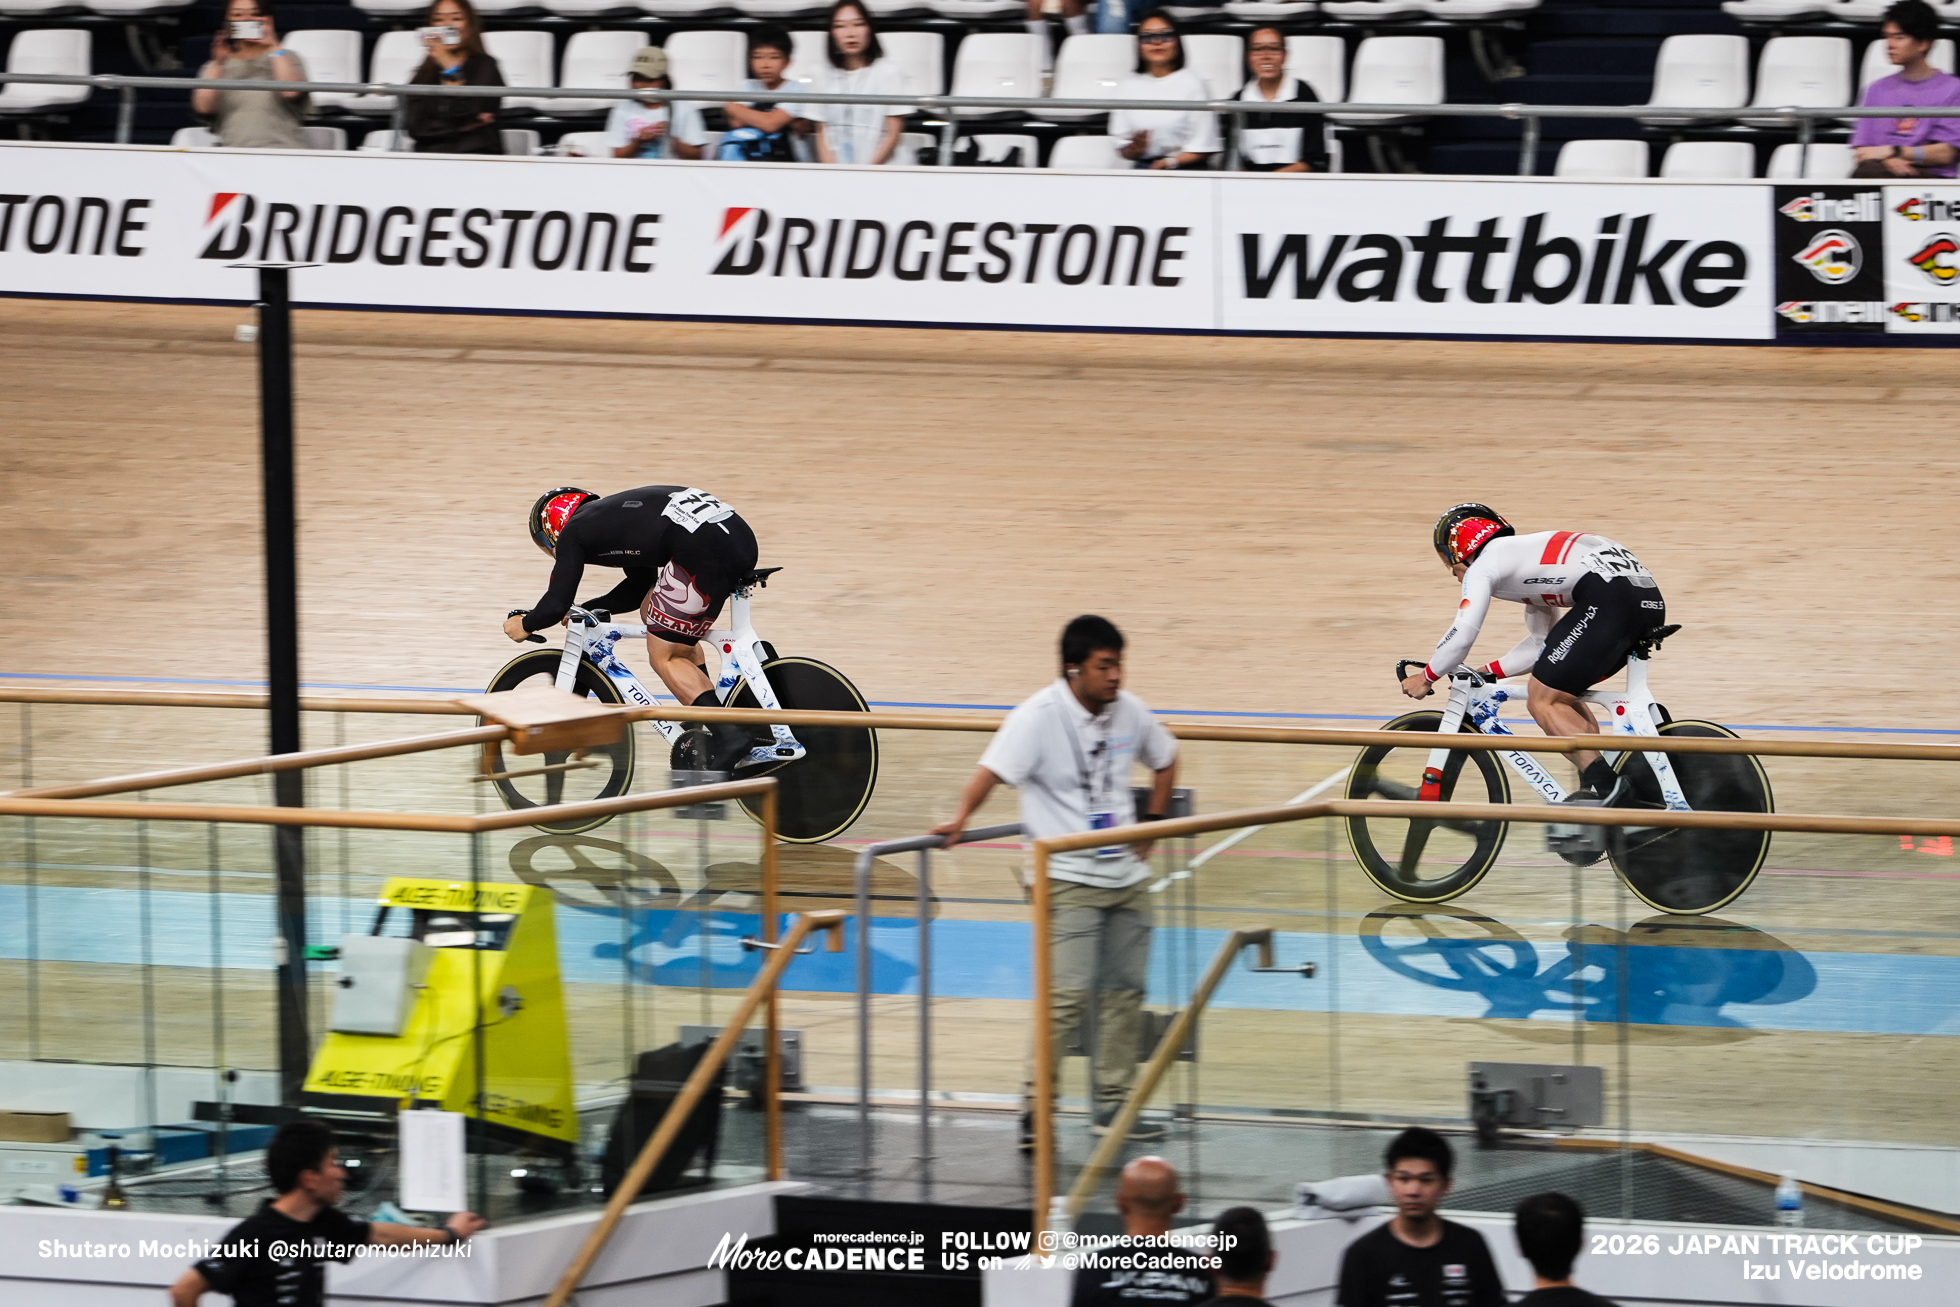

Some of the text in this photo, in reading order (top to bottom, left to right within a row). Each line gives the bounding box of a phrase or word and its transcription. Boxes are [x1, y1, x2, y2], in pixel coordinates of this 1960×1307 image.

[198, 191, 664, 273] BRIDGESTONE
[710, 206, 1191, 288] BRIDGESTONE
[1239, 212, 1748, 308] wattbike
[1467, 523, 1495, 551] JAPAN
[1509, 749, 1559, 800] TORAYCA
